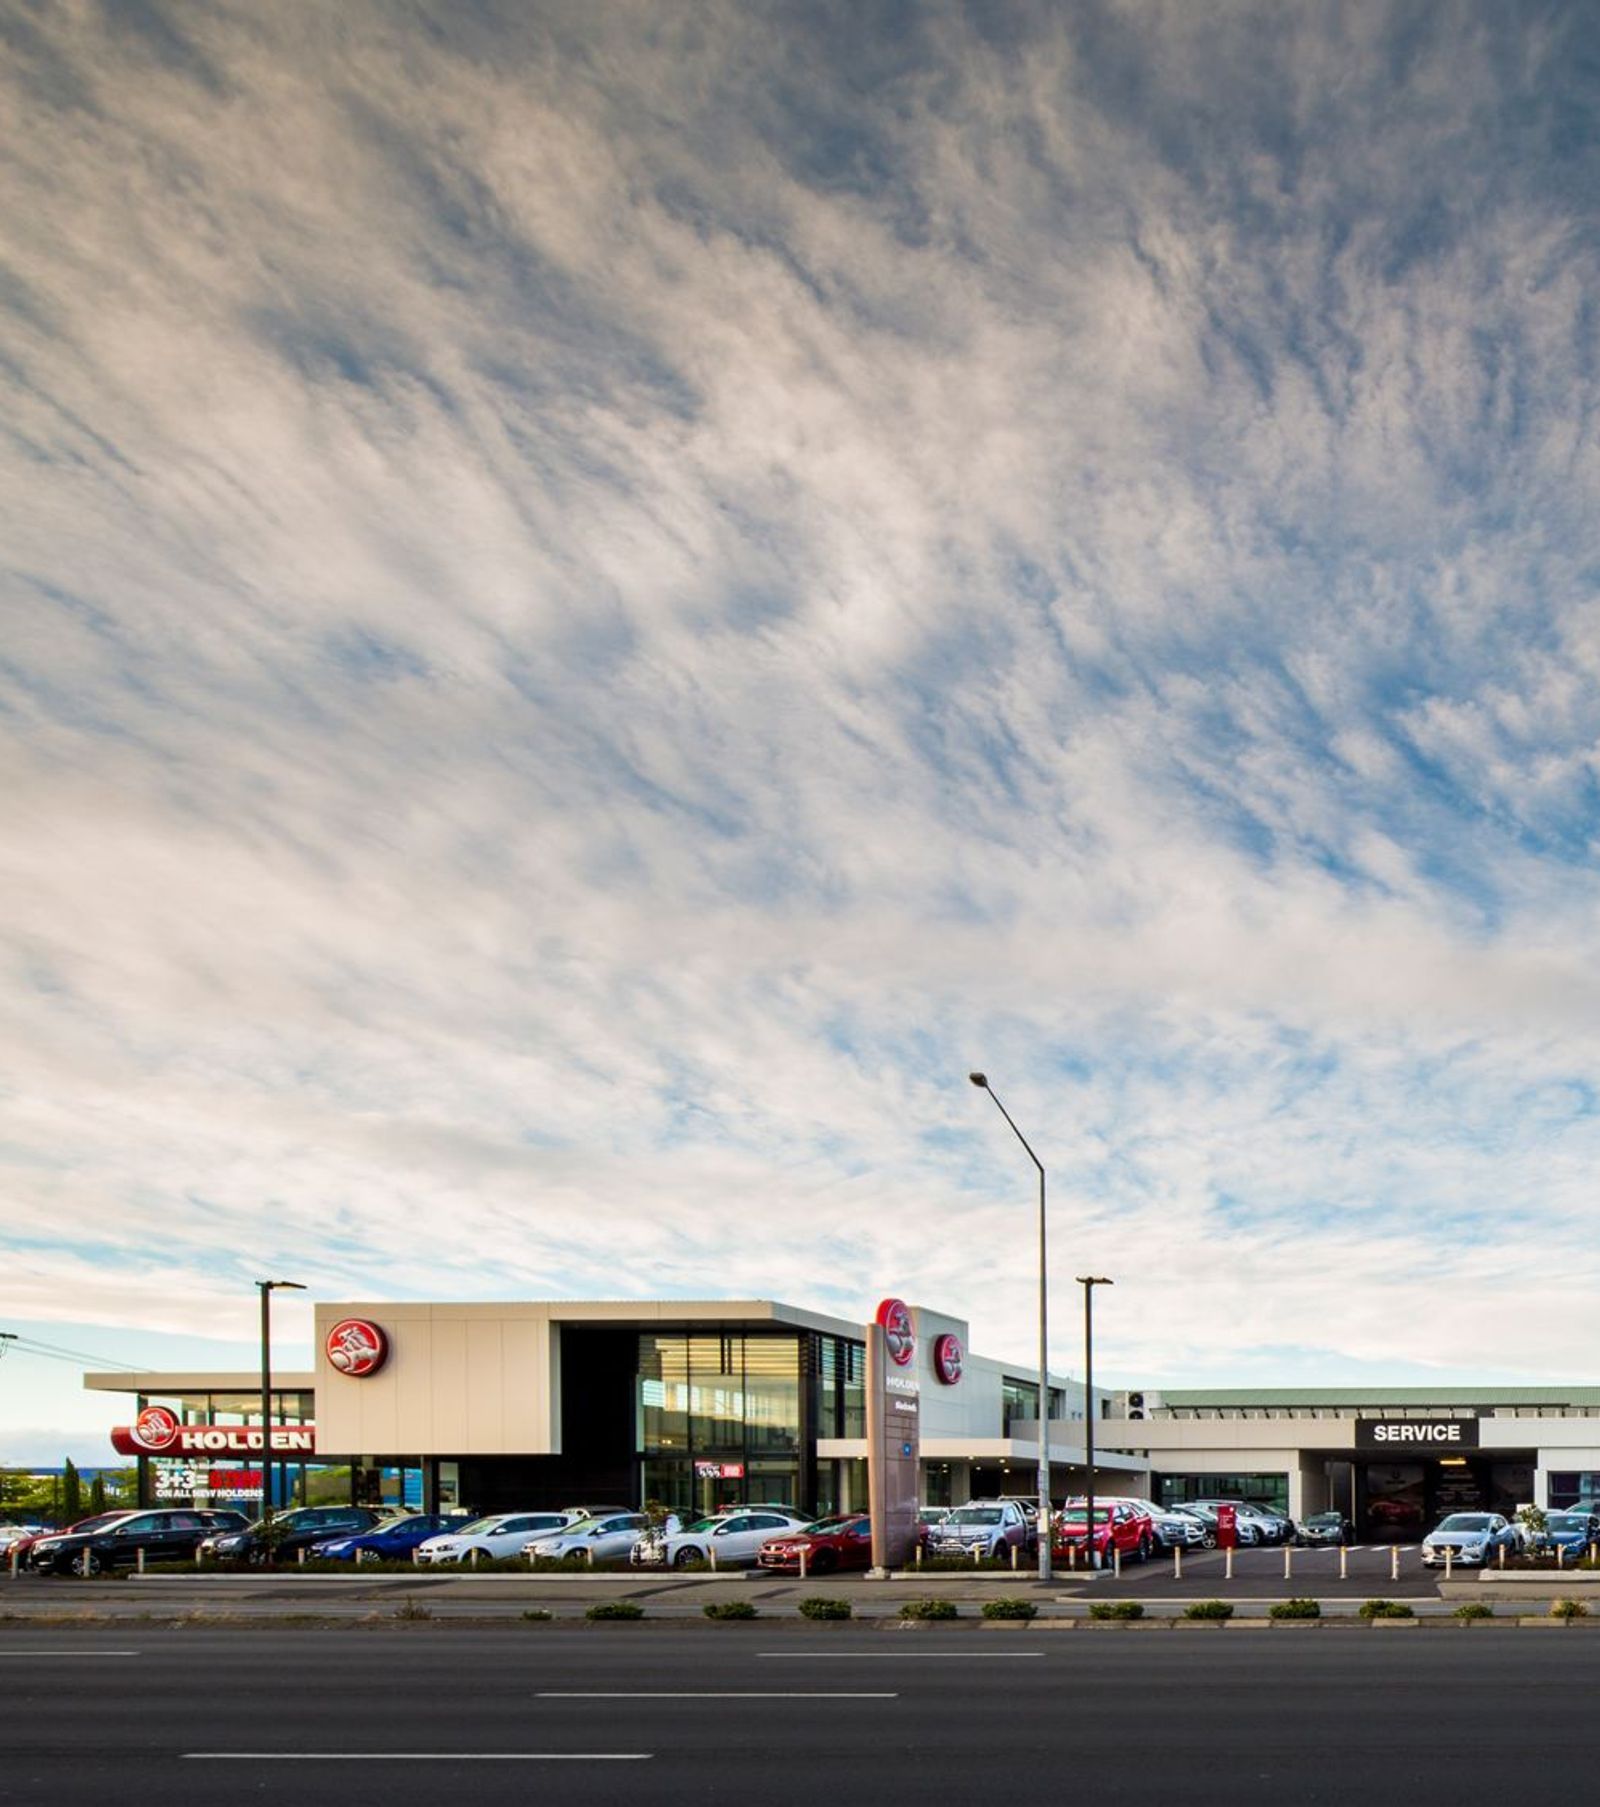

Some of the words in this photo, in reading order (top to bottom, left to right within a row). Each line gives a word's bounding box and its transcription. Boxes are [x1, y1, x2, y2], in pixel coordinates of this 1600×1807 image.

[181, 1431, 313, 1449] HOLDEN
[1373, 1424, 1461, 1441] SERVICE
[173, 1489, 191, 1497] ALL
